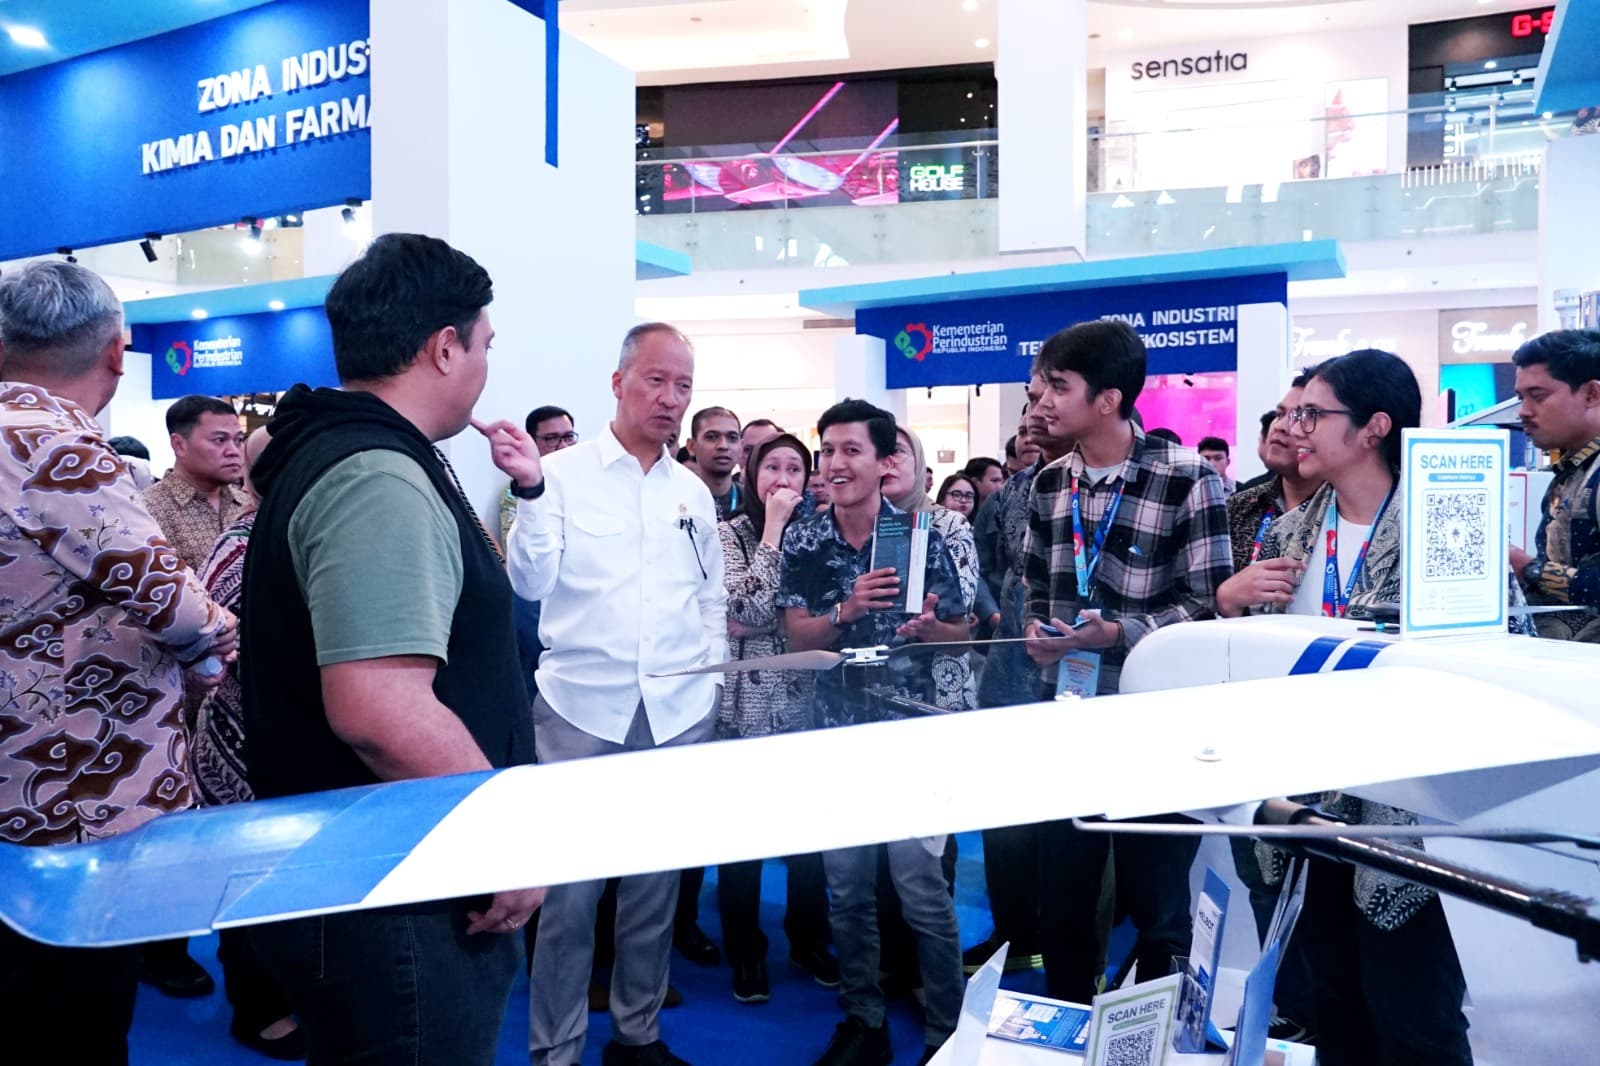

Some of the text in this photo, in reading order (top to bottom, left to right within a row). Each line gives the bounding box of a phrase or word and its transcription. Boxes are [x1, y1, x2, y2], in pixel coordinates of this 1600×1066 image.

[1131, 50, 1247, 80] sensatia
[197, 37, 370, 113] ZONA INDUS
[141, 94, 371, 175] KIMIA DAN FARM
[910, 164, 964, 180] GOLF
[910, 176, 964, 192] HOUSE
[1152, 305, 1235, 327] INDUSTRI
[932, 320, 1005, 337] Kementerian
[932, 332, 1008, 349] Perindustrian
[1420, 454, 1493, 469] SCAN HERE
[1107, 998, 1166, 1024] SCAN HERE
